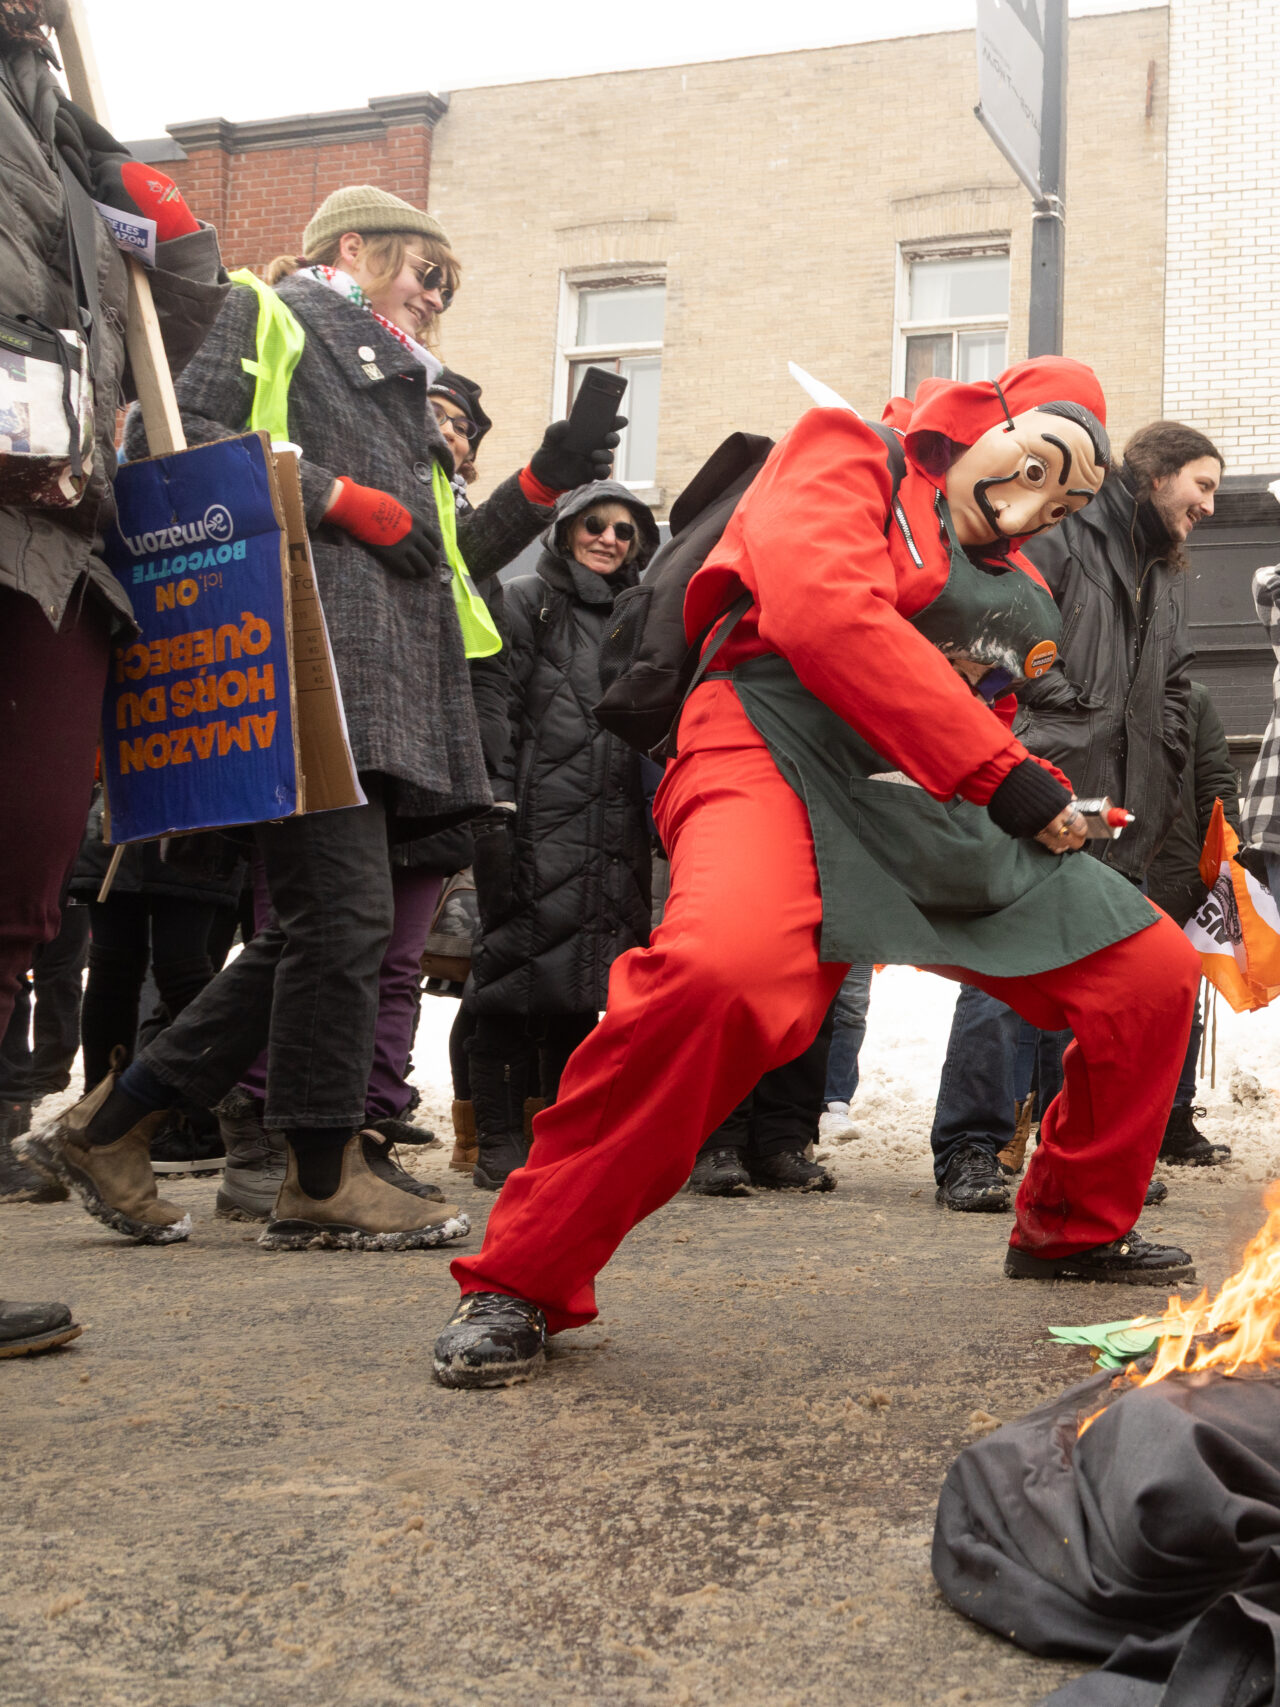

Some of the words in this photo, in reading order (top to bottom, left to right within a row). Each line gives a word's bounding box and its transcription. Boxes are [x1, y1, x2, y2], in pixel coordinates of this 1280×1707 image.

[120, 222, 140, 236] LES
[132, 539, 247, 584] BOYCOTTE
[156, 578, 199, 612] ON
[116, 685, 168, 730] DU
[171, 663, 276, 718] HORS
[119, 710, 278, 775] AMAZON
[1192, 902, 1231, 946] SN
